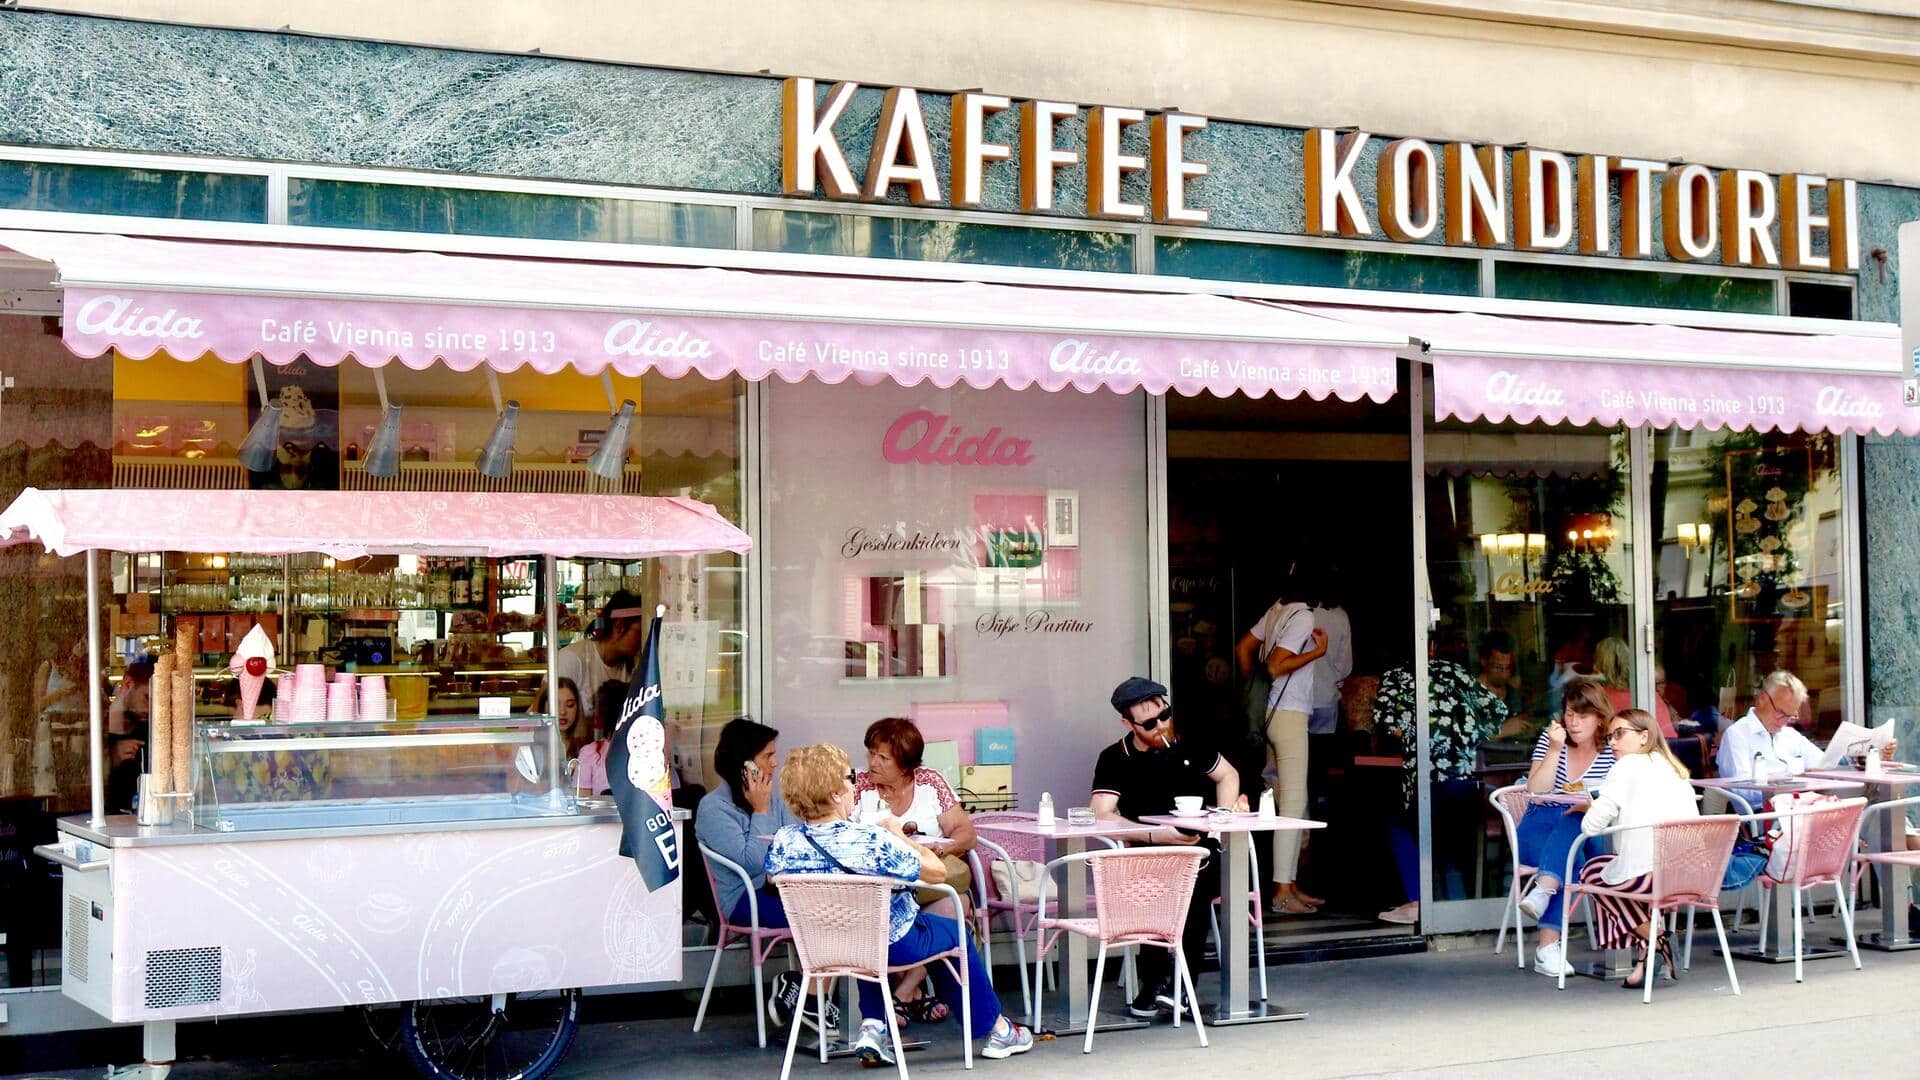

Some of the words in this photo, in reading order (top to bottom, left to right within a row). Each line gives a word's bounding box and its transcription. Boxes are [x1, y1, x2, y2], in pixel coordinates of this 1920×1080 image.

[785, 77, 1209, 223] KAFFEE
[1305, 127, 1860, 271] KONDITOREI
[260, 318, 318, 343] Café
[328, 321, 414, 349] Vienna
[424, 326, 488, 351] since
[498, 328, 556, 353] 1913
[758, 339, 807, 363] Café
[815, 342, 890, 368] Vienna
[898, 346, 950, 370] since
[958, 349, 1010, 371] 1913
[1179, 358, 1220, 379] Café
[1226, 359, 1292, 382] Vienna
[1298, 365, 1341, 383] since
[1349, 366, 1393, 386] 1913
[1600, 388, 1636, 410] Café
[1640, 390, 1697, 413] Vienna
[1703, 393, 1741, 413] since
[1748, 395, 1785, 415] 1913
[841, 526, 961, 559] Geschenkideen
[1024, 609, 1094, 634] Partitur
